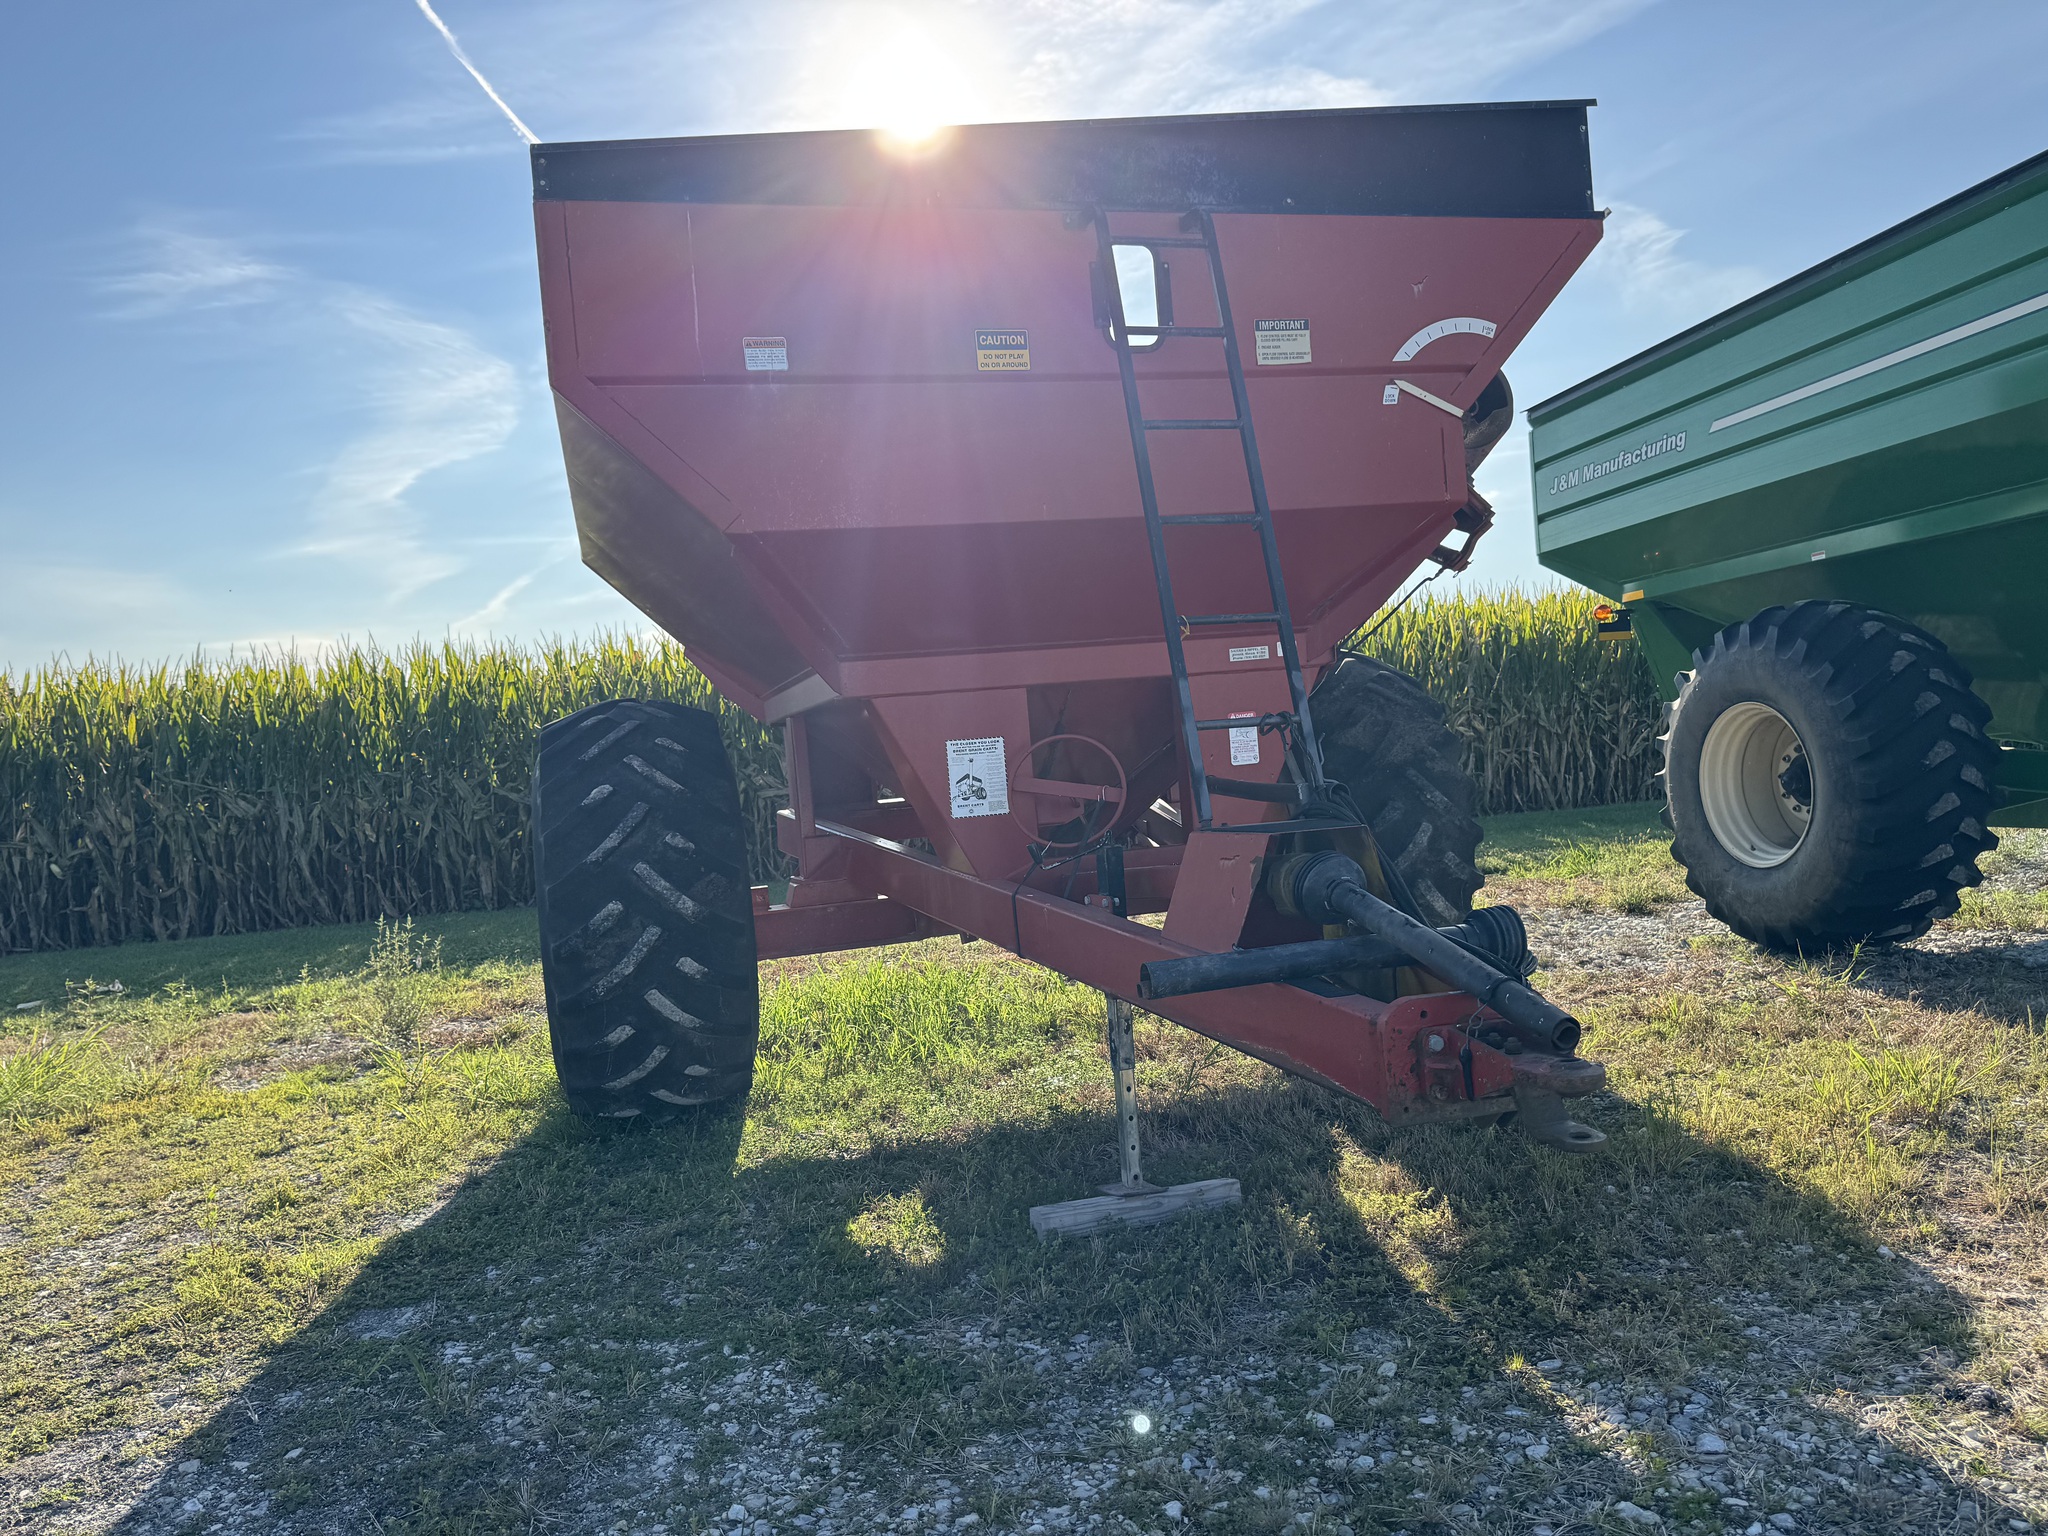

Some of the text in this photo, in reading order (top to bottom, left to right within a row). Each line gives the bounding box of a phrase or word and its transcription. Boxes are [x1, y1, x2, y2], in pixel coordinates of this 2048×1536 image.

[1258, 320, 1305, 330] IMPORTANT
[980, 335, 1025, 345] CAUTION
[1550, 430, 1687, 496] J&M Manufacturing
